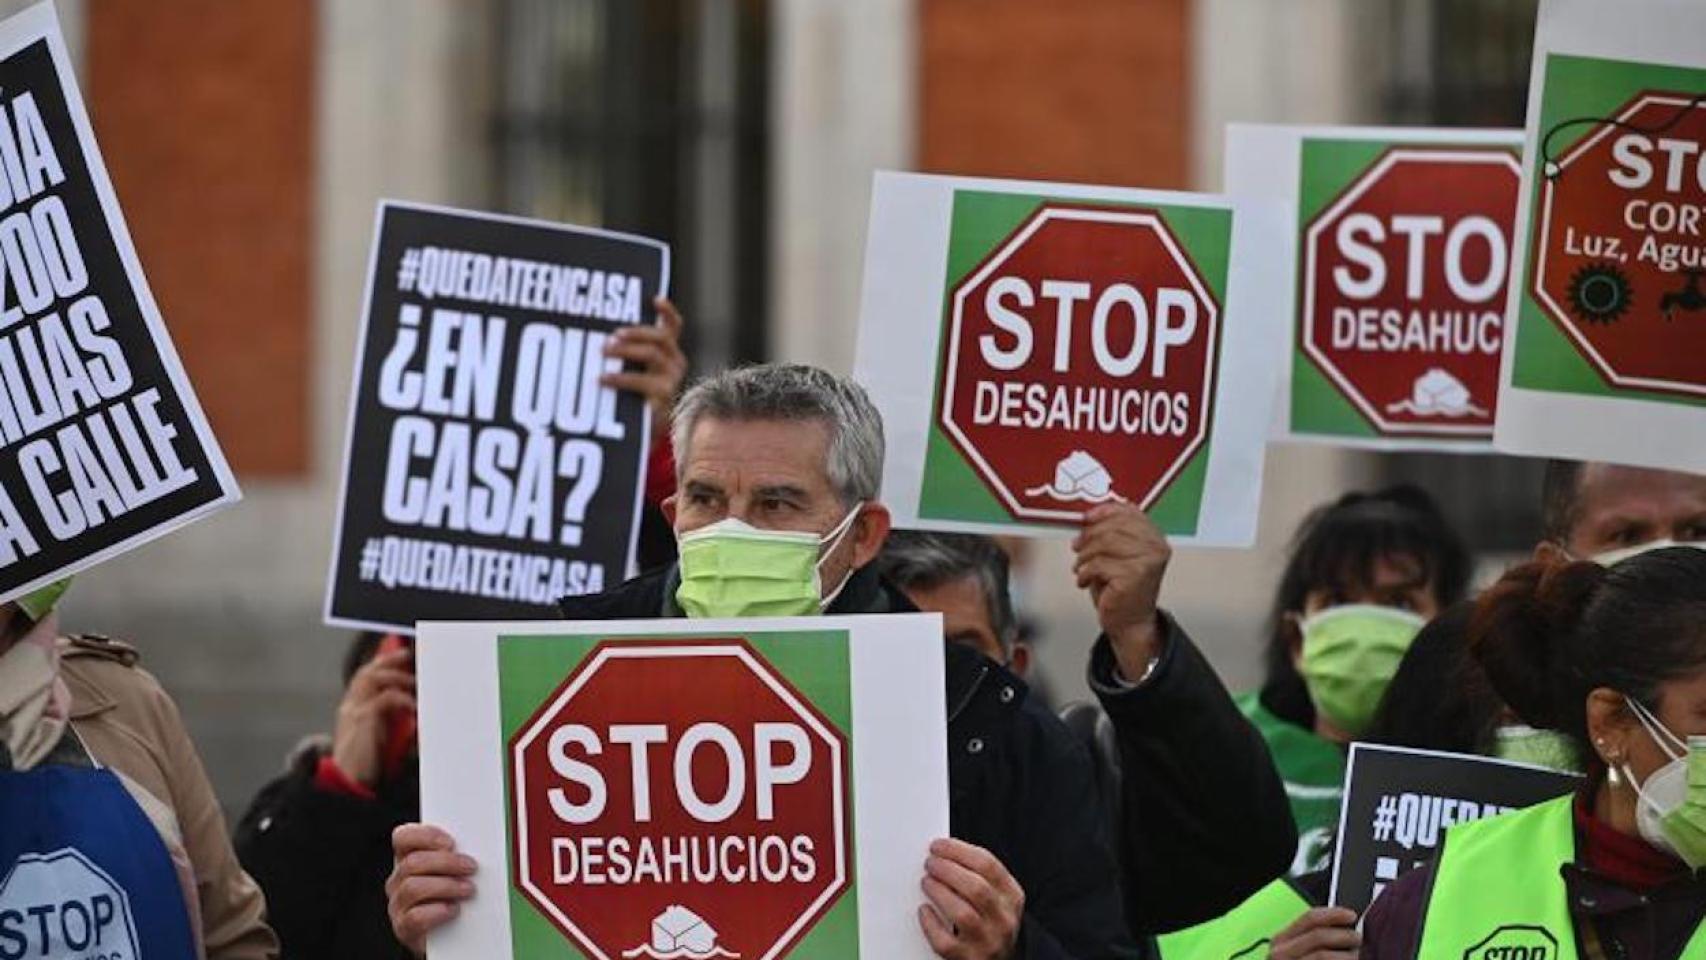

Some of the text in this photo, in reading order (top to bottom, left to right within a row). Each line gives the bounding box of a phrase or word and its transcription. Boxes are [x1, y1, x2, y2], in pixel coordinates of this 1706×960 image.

[1564, 226, 1706, 271] Luz, Agu
[1623, 199, 1706, 236] COR
[397, 246, 642, 323] #QUEDATEENCASA
[1332, 213, 1508, 302] STO
[378, 303, 507, 421] ¿EN
[978, 276, 1198, 378] STOP
[1331, 308, 1501, 355] DESAHUC
[0, 295, 134, 448] ILIAS
[973, 380, 1190, 437] DESAHUCIOS
[18, 388, 199, 541] CALLE
[382, 416, 603, 546] CASA?
[359, 535, 605, 606] #QUEDATEENCASA
[547, 722, 813, 824] STOP
[1372, 793, 1517, 849] #QUE
[551, 835, 817, 884] DESAHUCIOS
[0, 893, 113, 960] STOP
